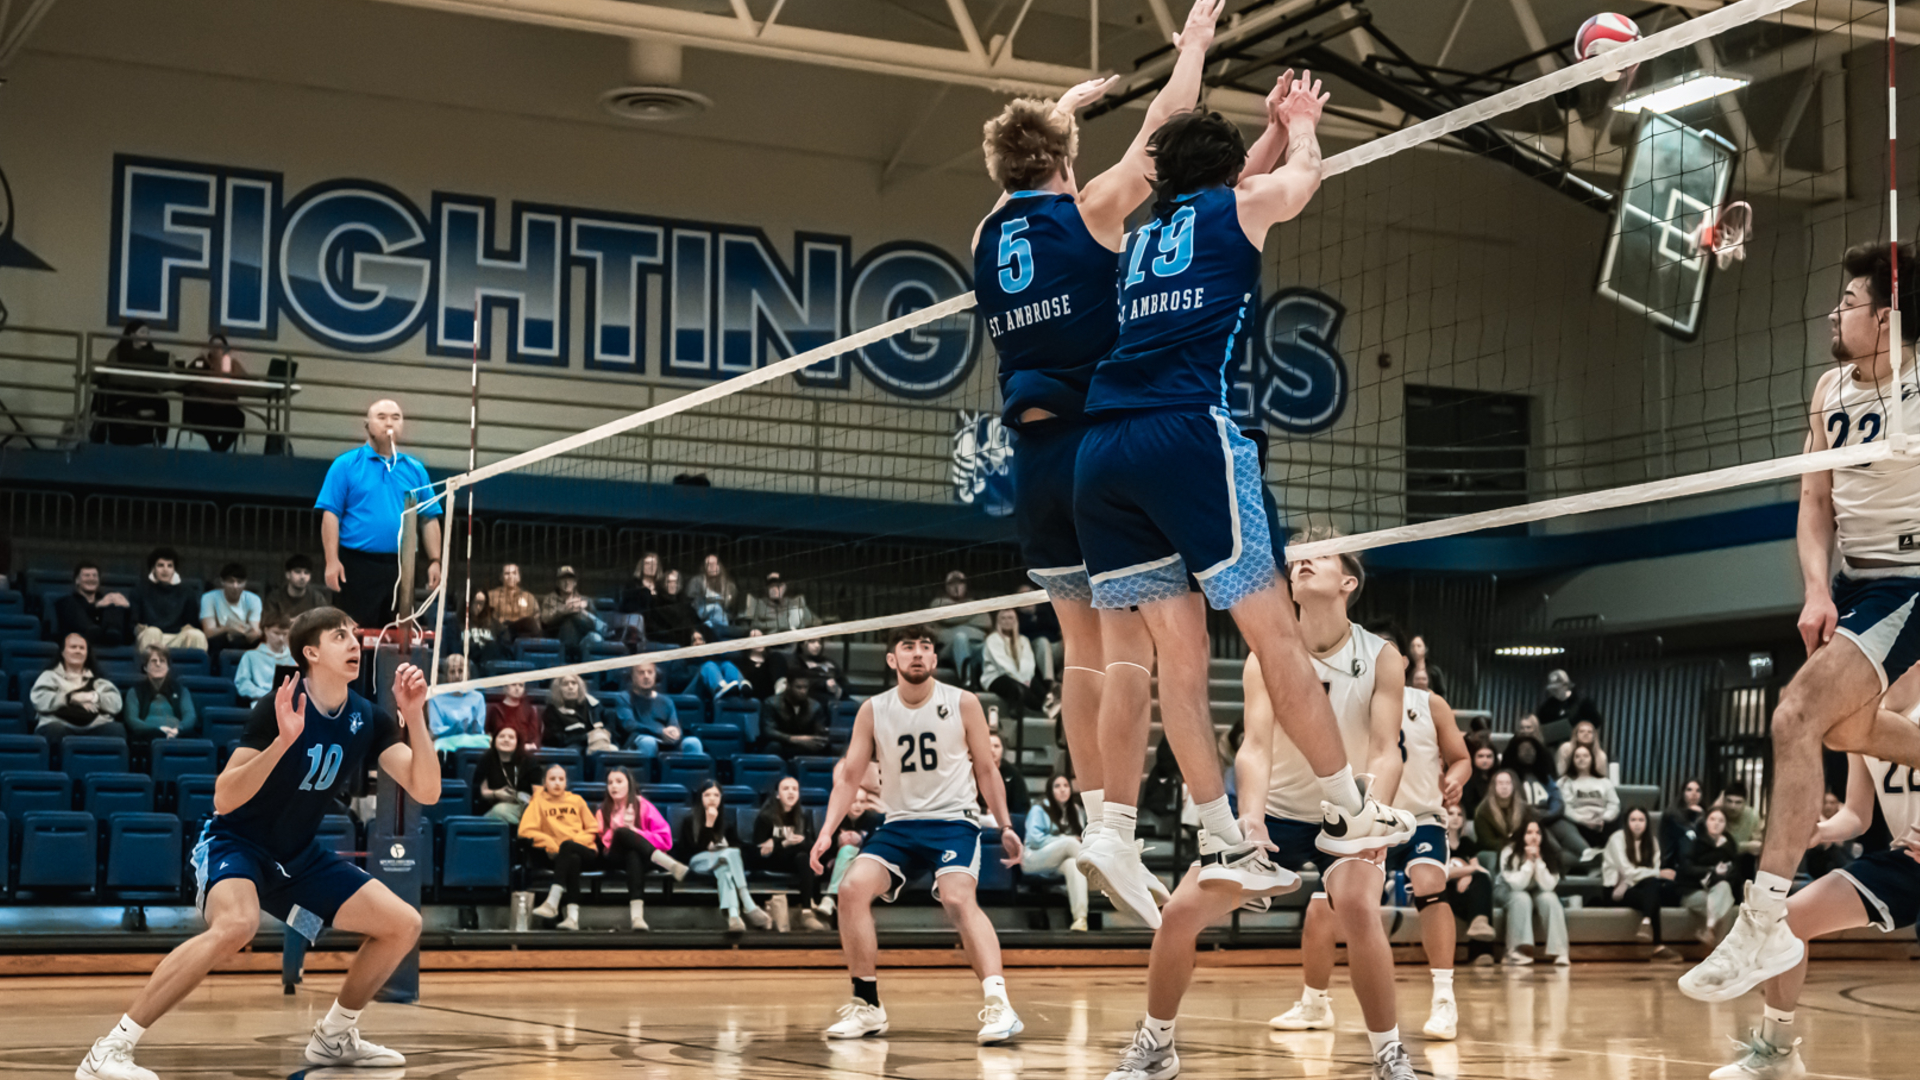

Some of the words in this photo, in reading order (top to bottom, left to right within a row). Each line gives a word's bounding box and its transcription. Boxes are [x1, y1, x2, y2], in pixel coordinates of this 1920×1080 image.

[997, 216, 1035, 294] 5
[1124, 205, 1196, 290] 19
[108, 154, 981, 398] FIGHTING
[989, 316, 1004, 338] ST.
[1006, 294, 1072, 331] AMBROSE
[1130, 287, 1204, 320] AMBROSE
[298, 743, 344, 791] 10
[897, 731, 938, 773] 26
[545, 806, 577, 817] IOWA
